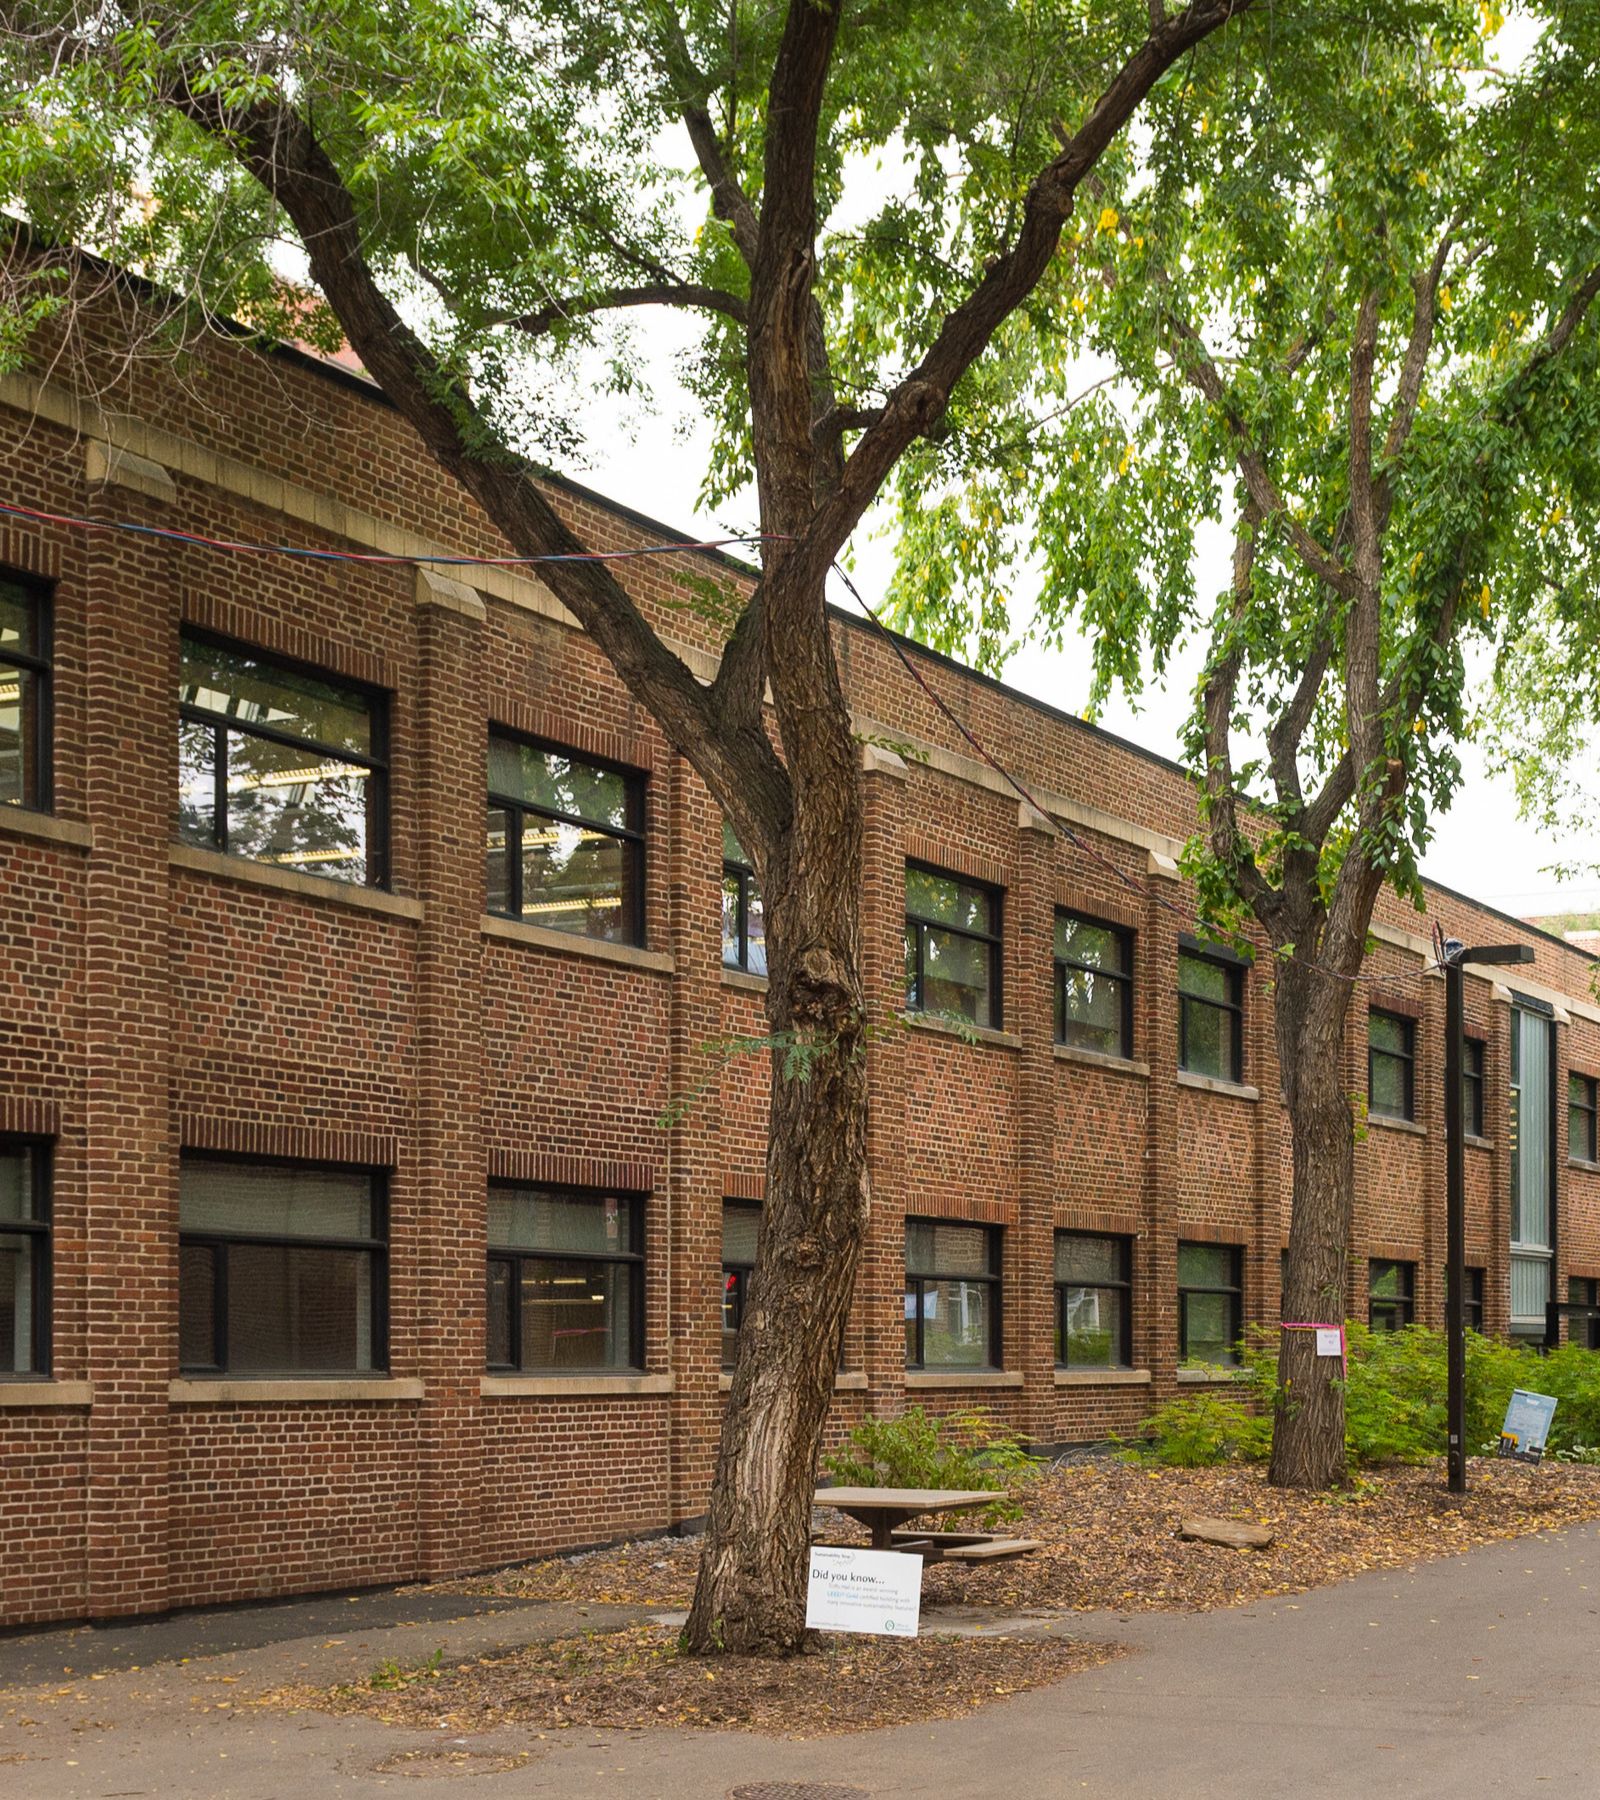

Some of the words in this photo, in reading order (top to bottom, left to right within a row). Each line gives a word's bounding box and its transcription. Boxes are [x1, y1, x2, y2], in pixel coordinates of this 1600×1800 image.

[812, 1569, 829, 1580] Did
[831, 1573, 848, 1583] you
[850, 1572, 885, 1585] know...
